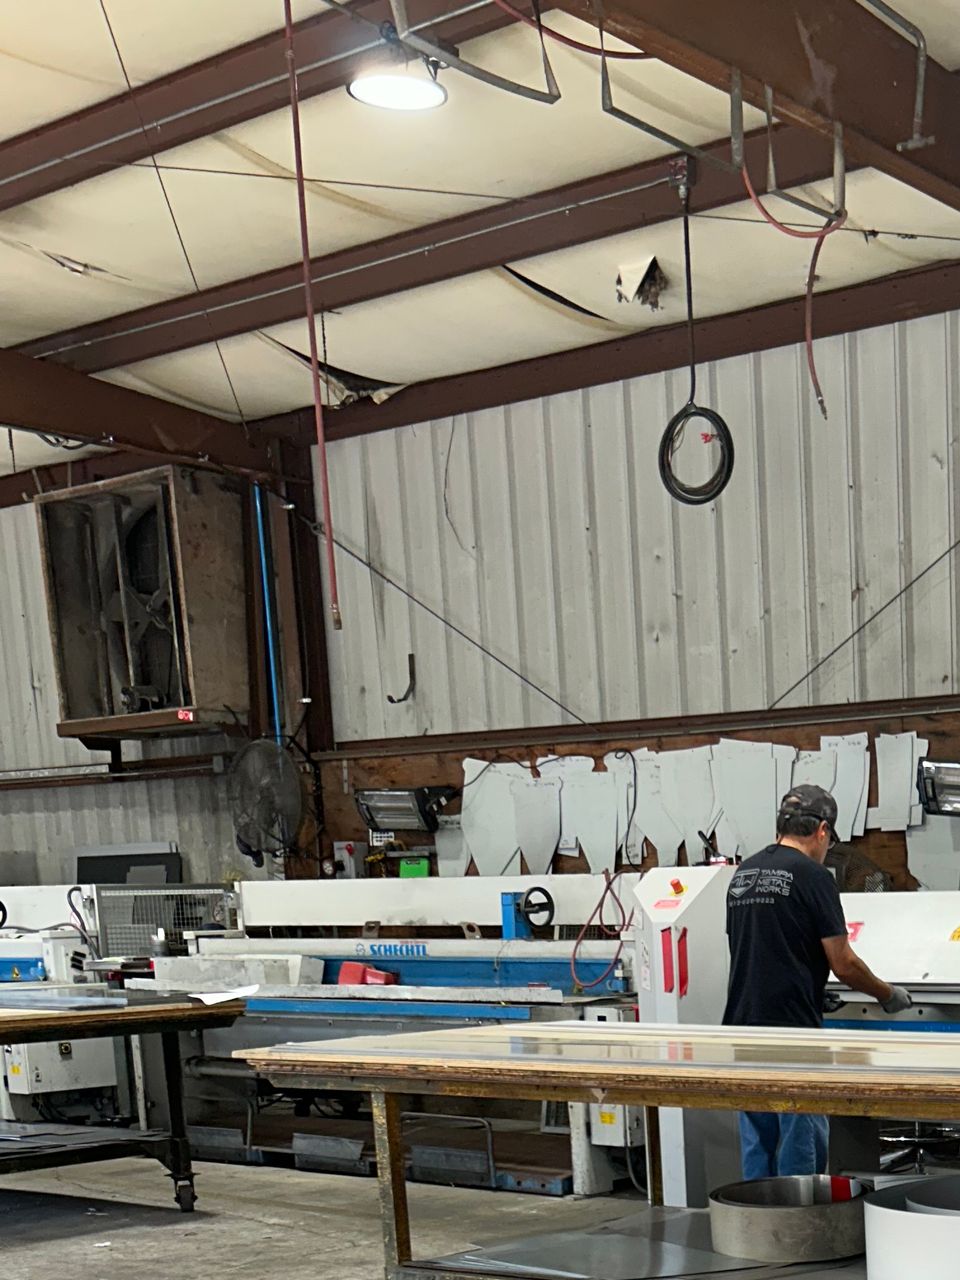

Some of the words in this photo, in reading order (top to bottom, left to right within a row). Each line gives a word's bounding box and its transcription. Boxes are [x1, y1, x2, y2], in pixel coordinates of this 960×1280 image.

[761, 869, 794, 881] TAMPA
[756, 878, 791, 889] METAL
[755, 886, 791, 897] WORKS
[369, 944, 428, 957] SCHECHTL
